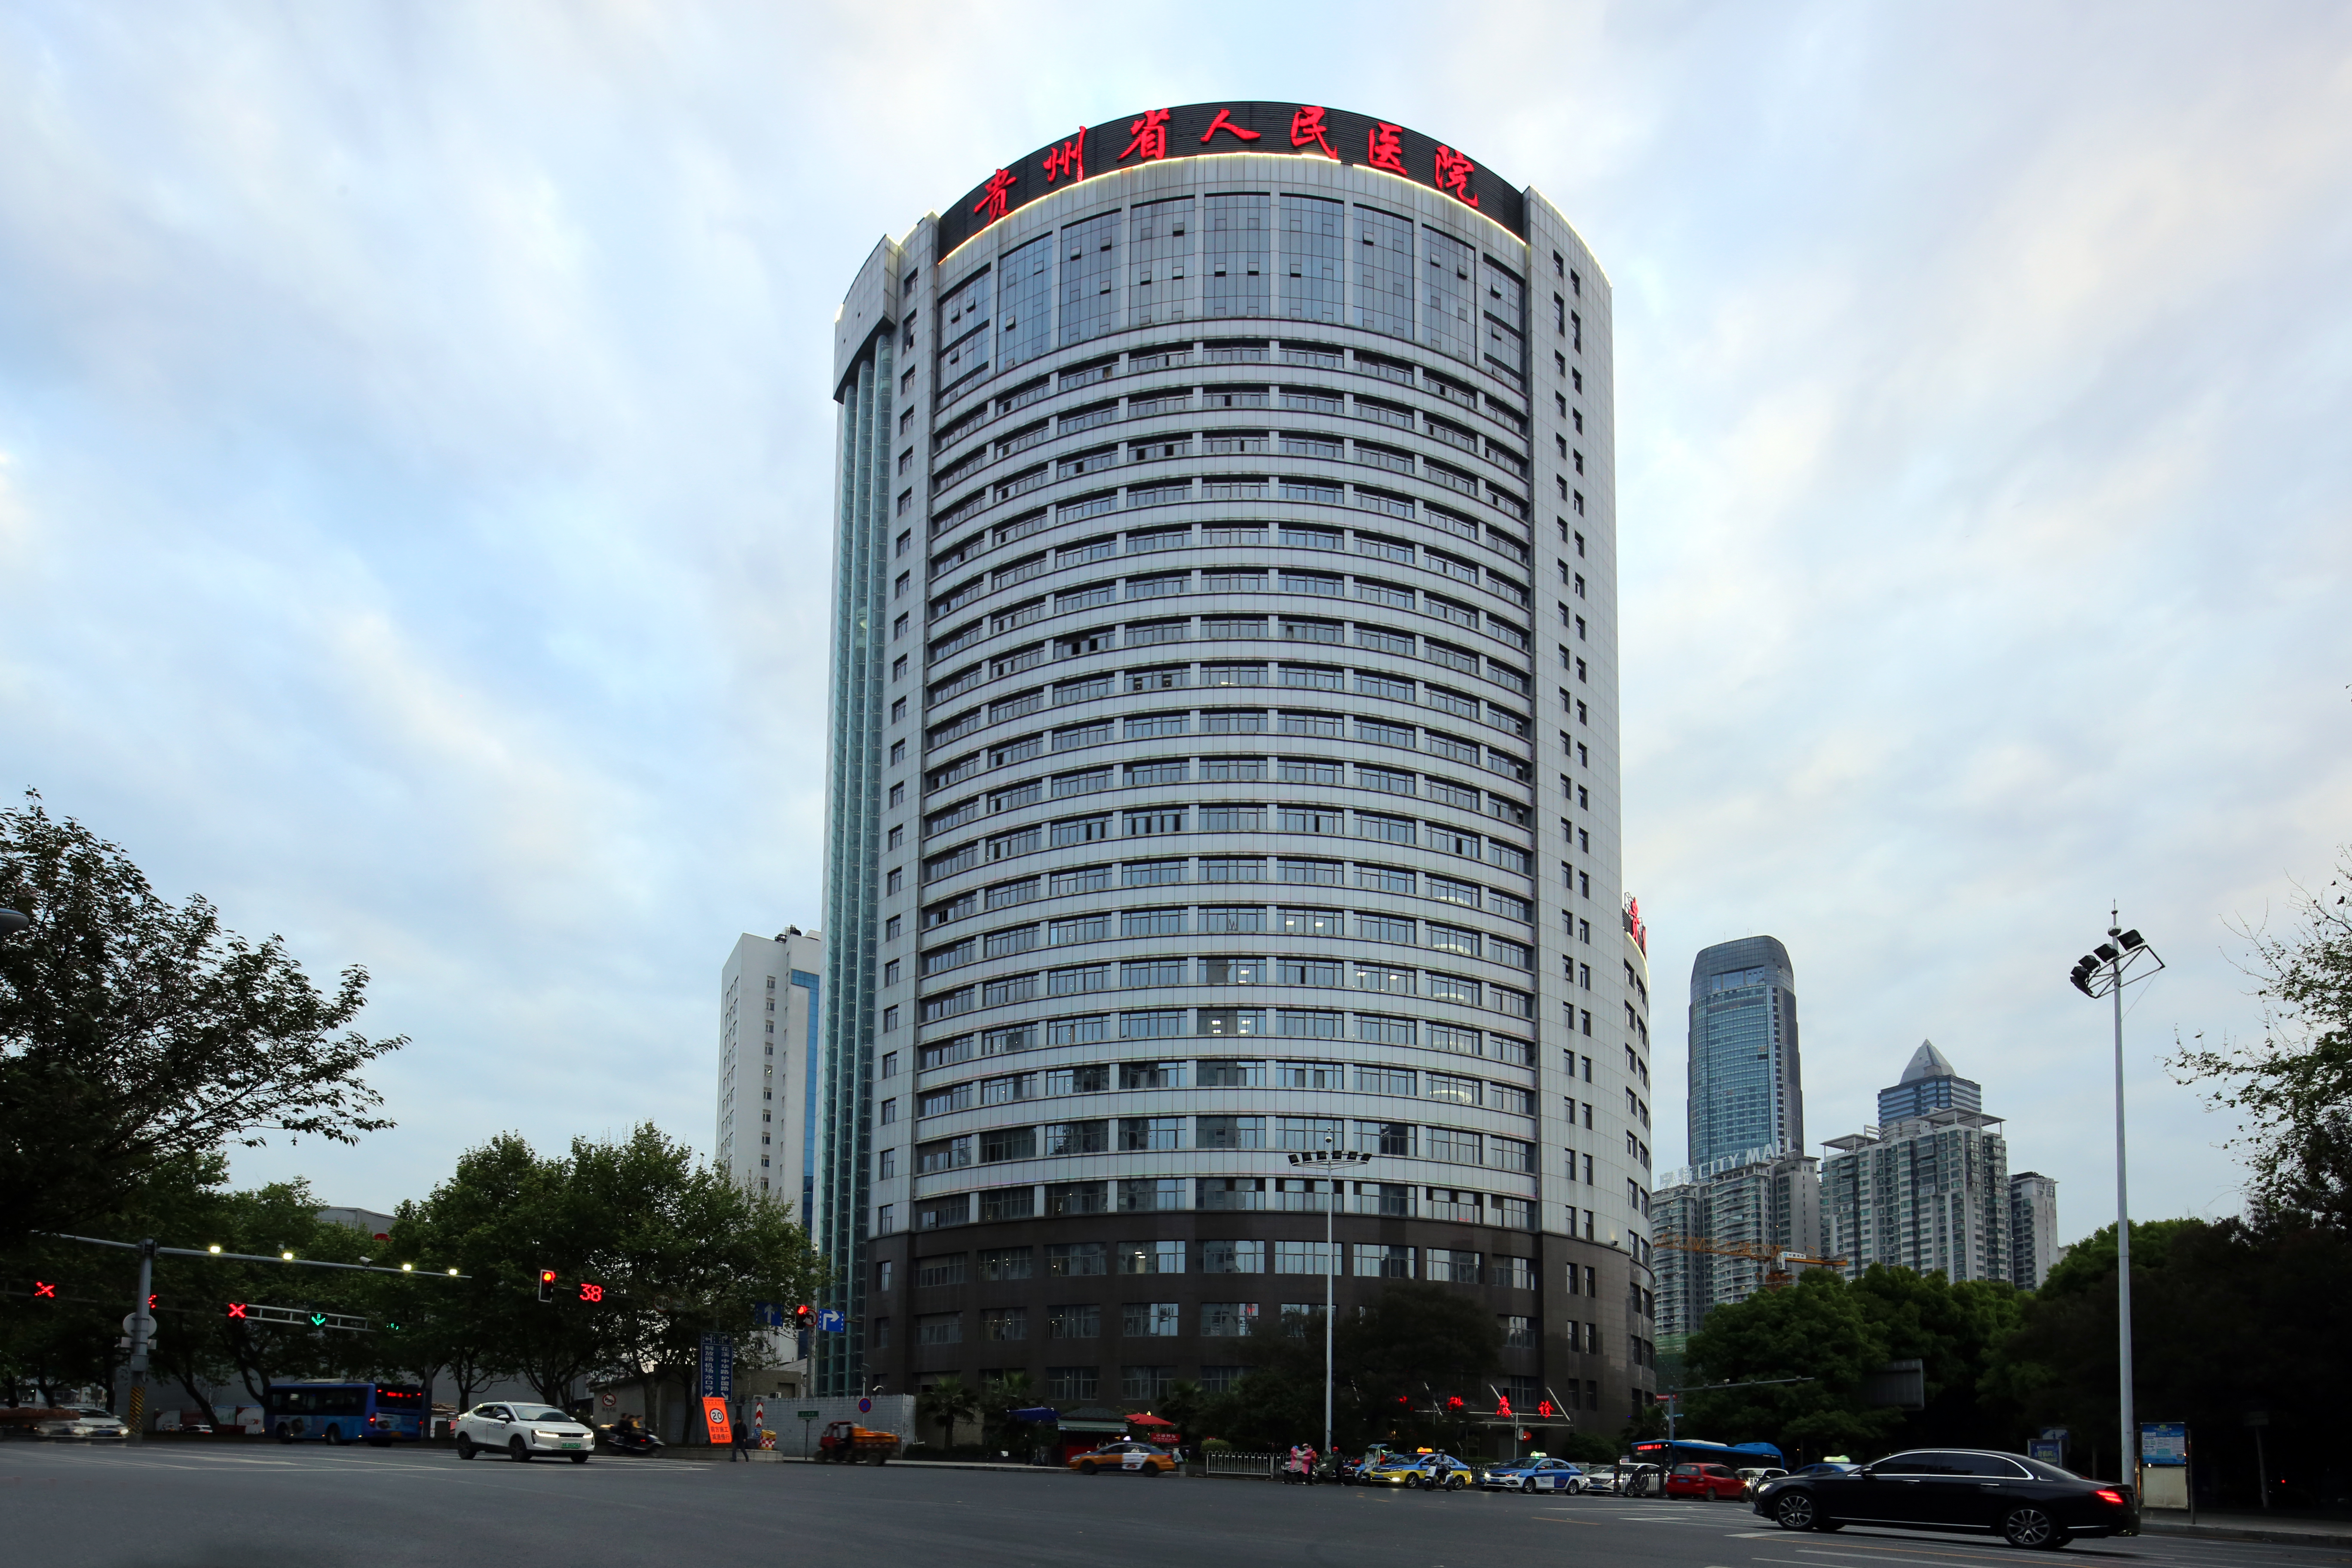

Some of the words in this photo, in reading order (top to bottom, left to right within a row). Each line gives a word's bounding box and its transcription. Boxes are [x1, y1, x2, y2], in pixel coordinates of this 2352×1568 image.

[974, 106, 1479, 225] 贵州省人民医院
[1698, 1153, 1739, 1179] CITY
[1745, 1137, 1796, 1165] MALL
[579, 1283, 603, 1302] 38
